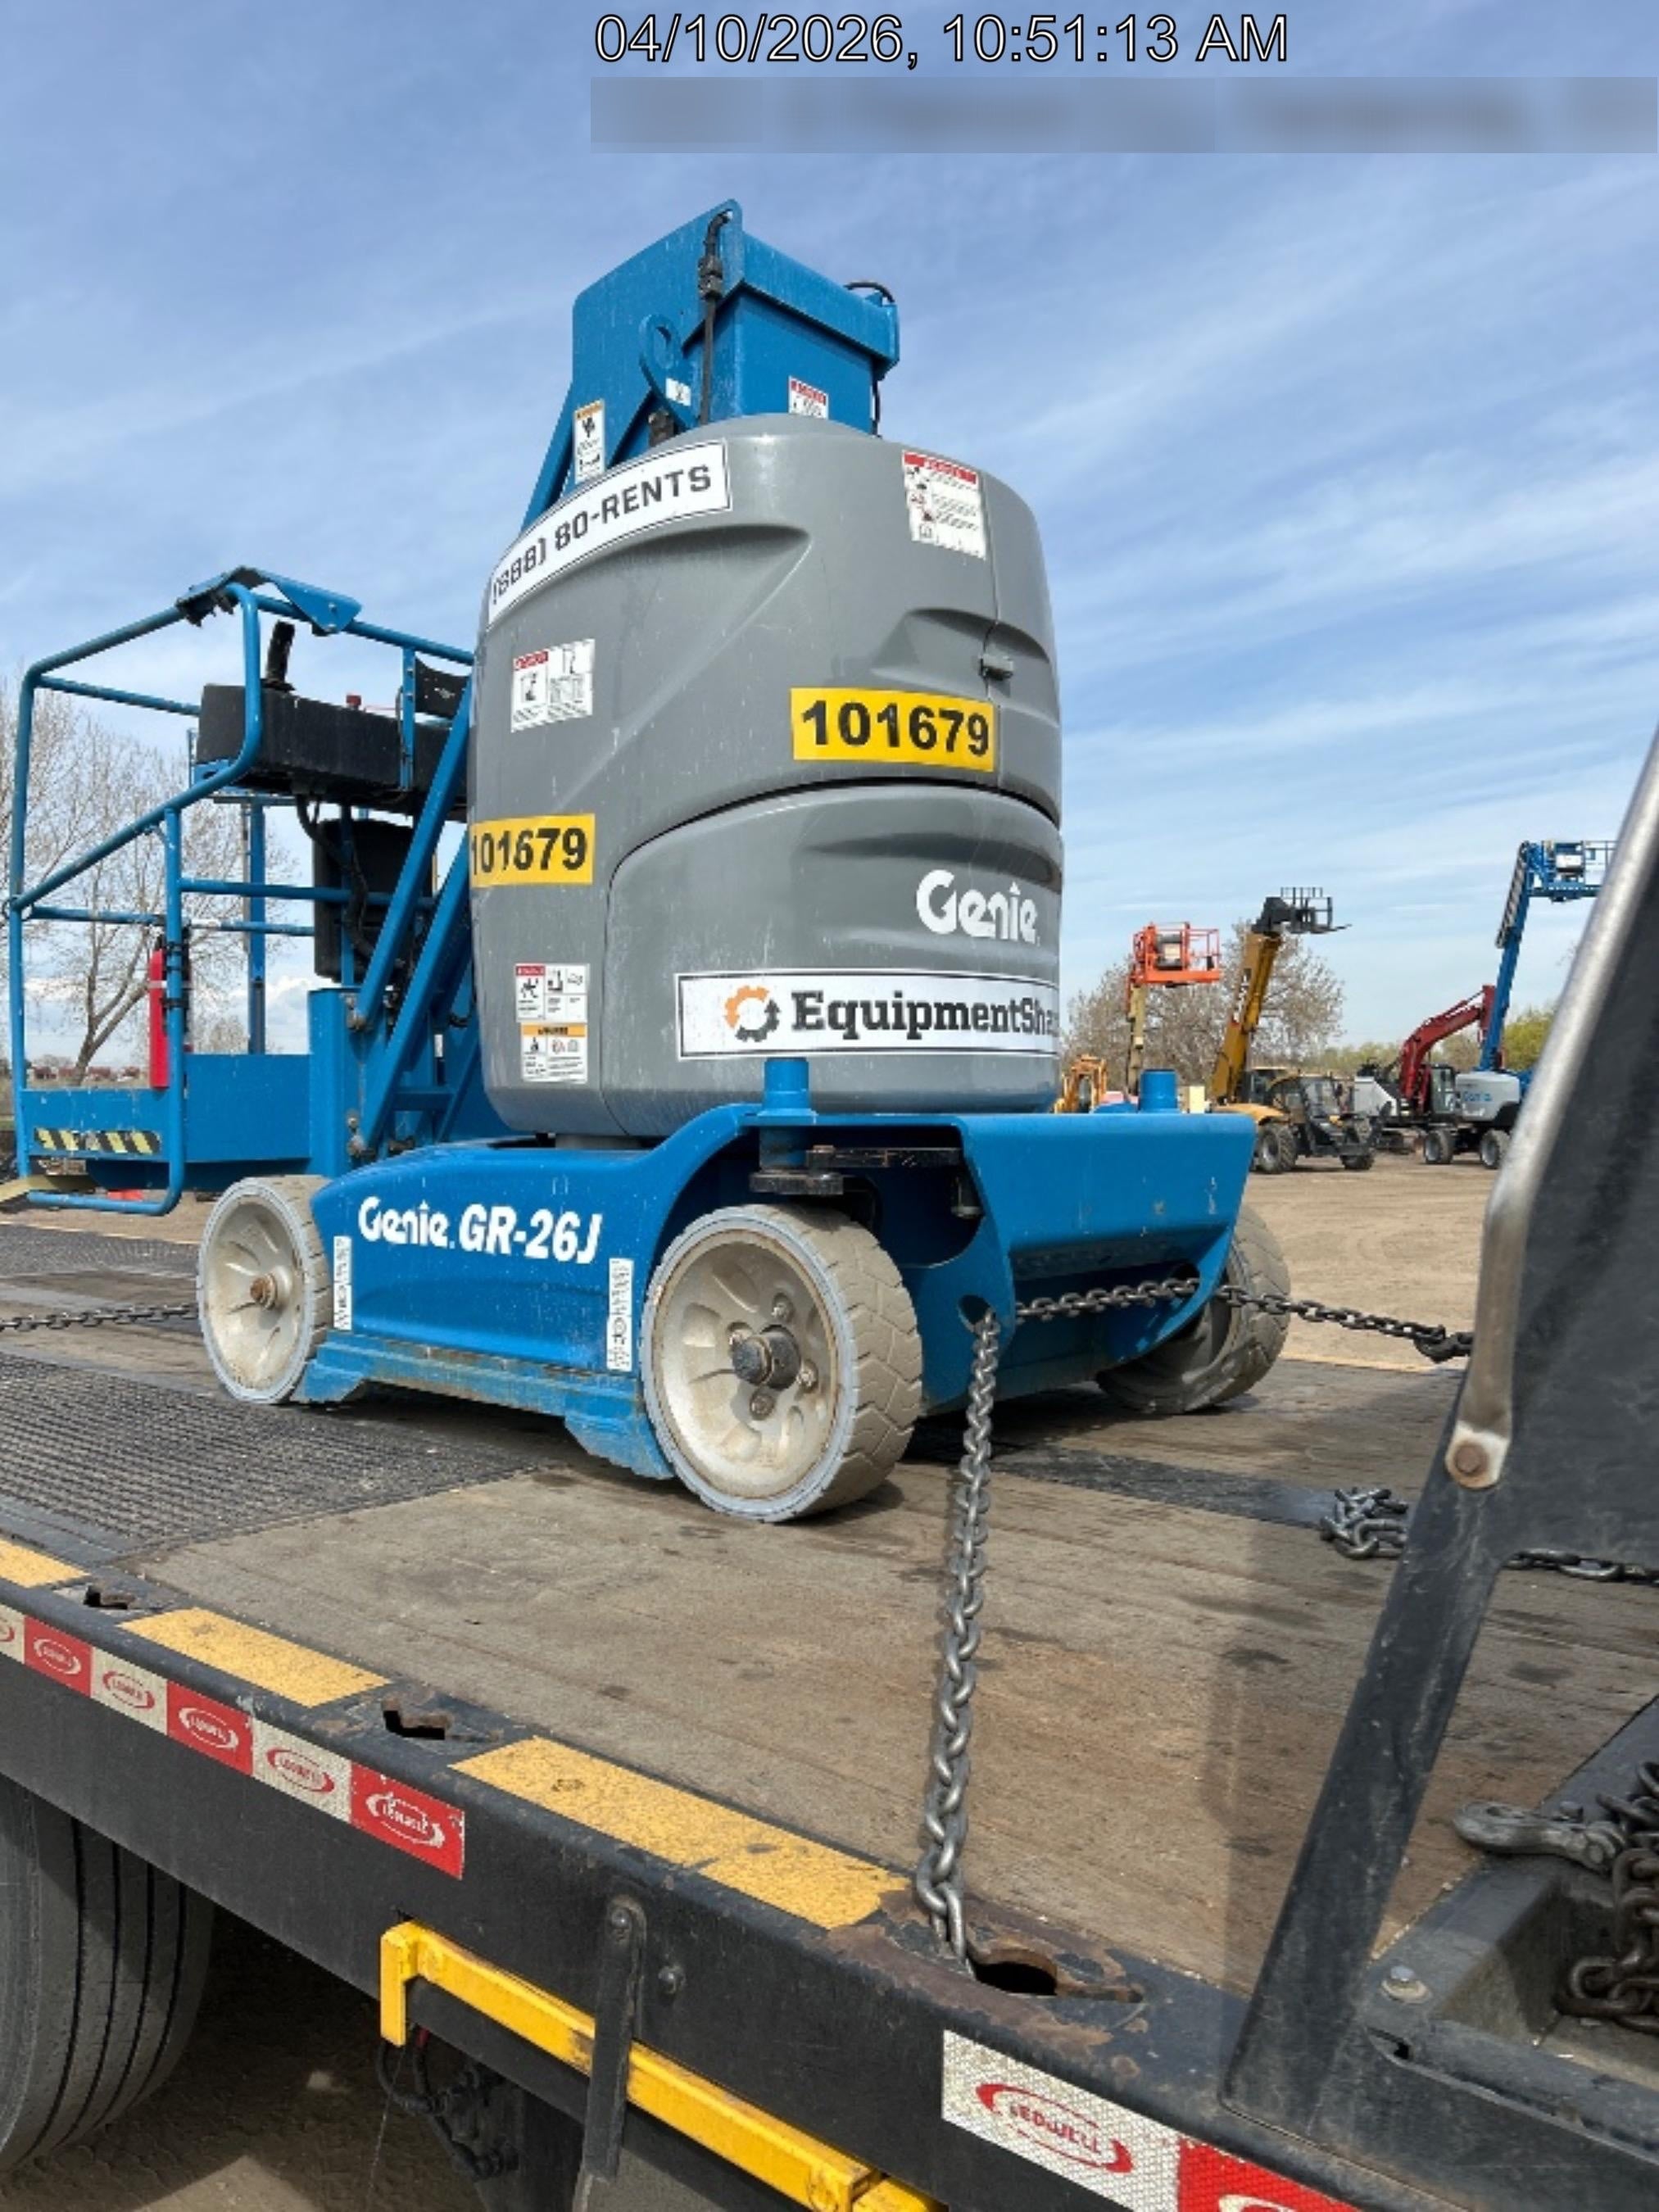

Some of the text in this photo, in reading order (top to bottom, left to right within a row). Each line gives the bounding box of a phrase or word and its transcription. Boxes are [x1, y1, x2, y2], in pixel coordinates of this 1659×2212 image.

[492, 464, 711, 605] (888) 80-RENTS
[802, 700, 989, 757] 101679
[472, 827, 587, 876] 101679
[916, 868, 1038, 945] Genie
[358, 1196, 603, 1264] Genie GR-26J
